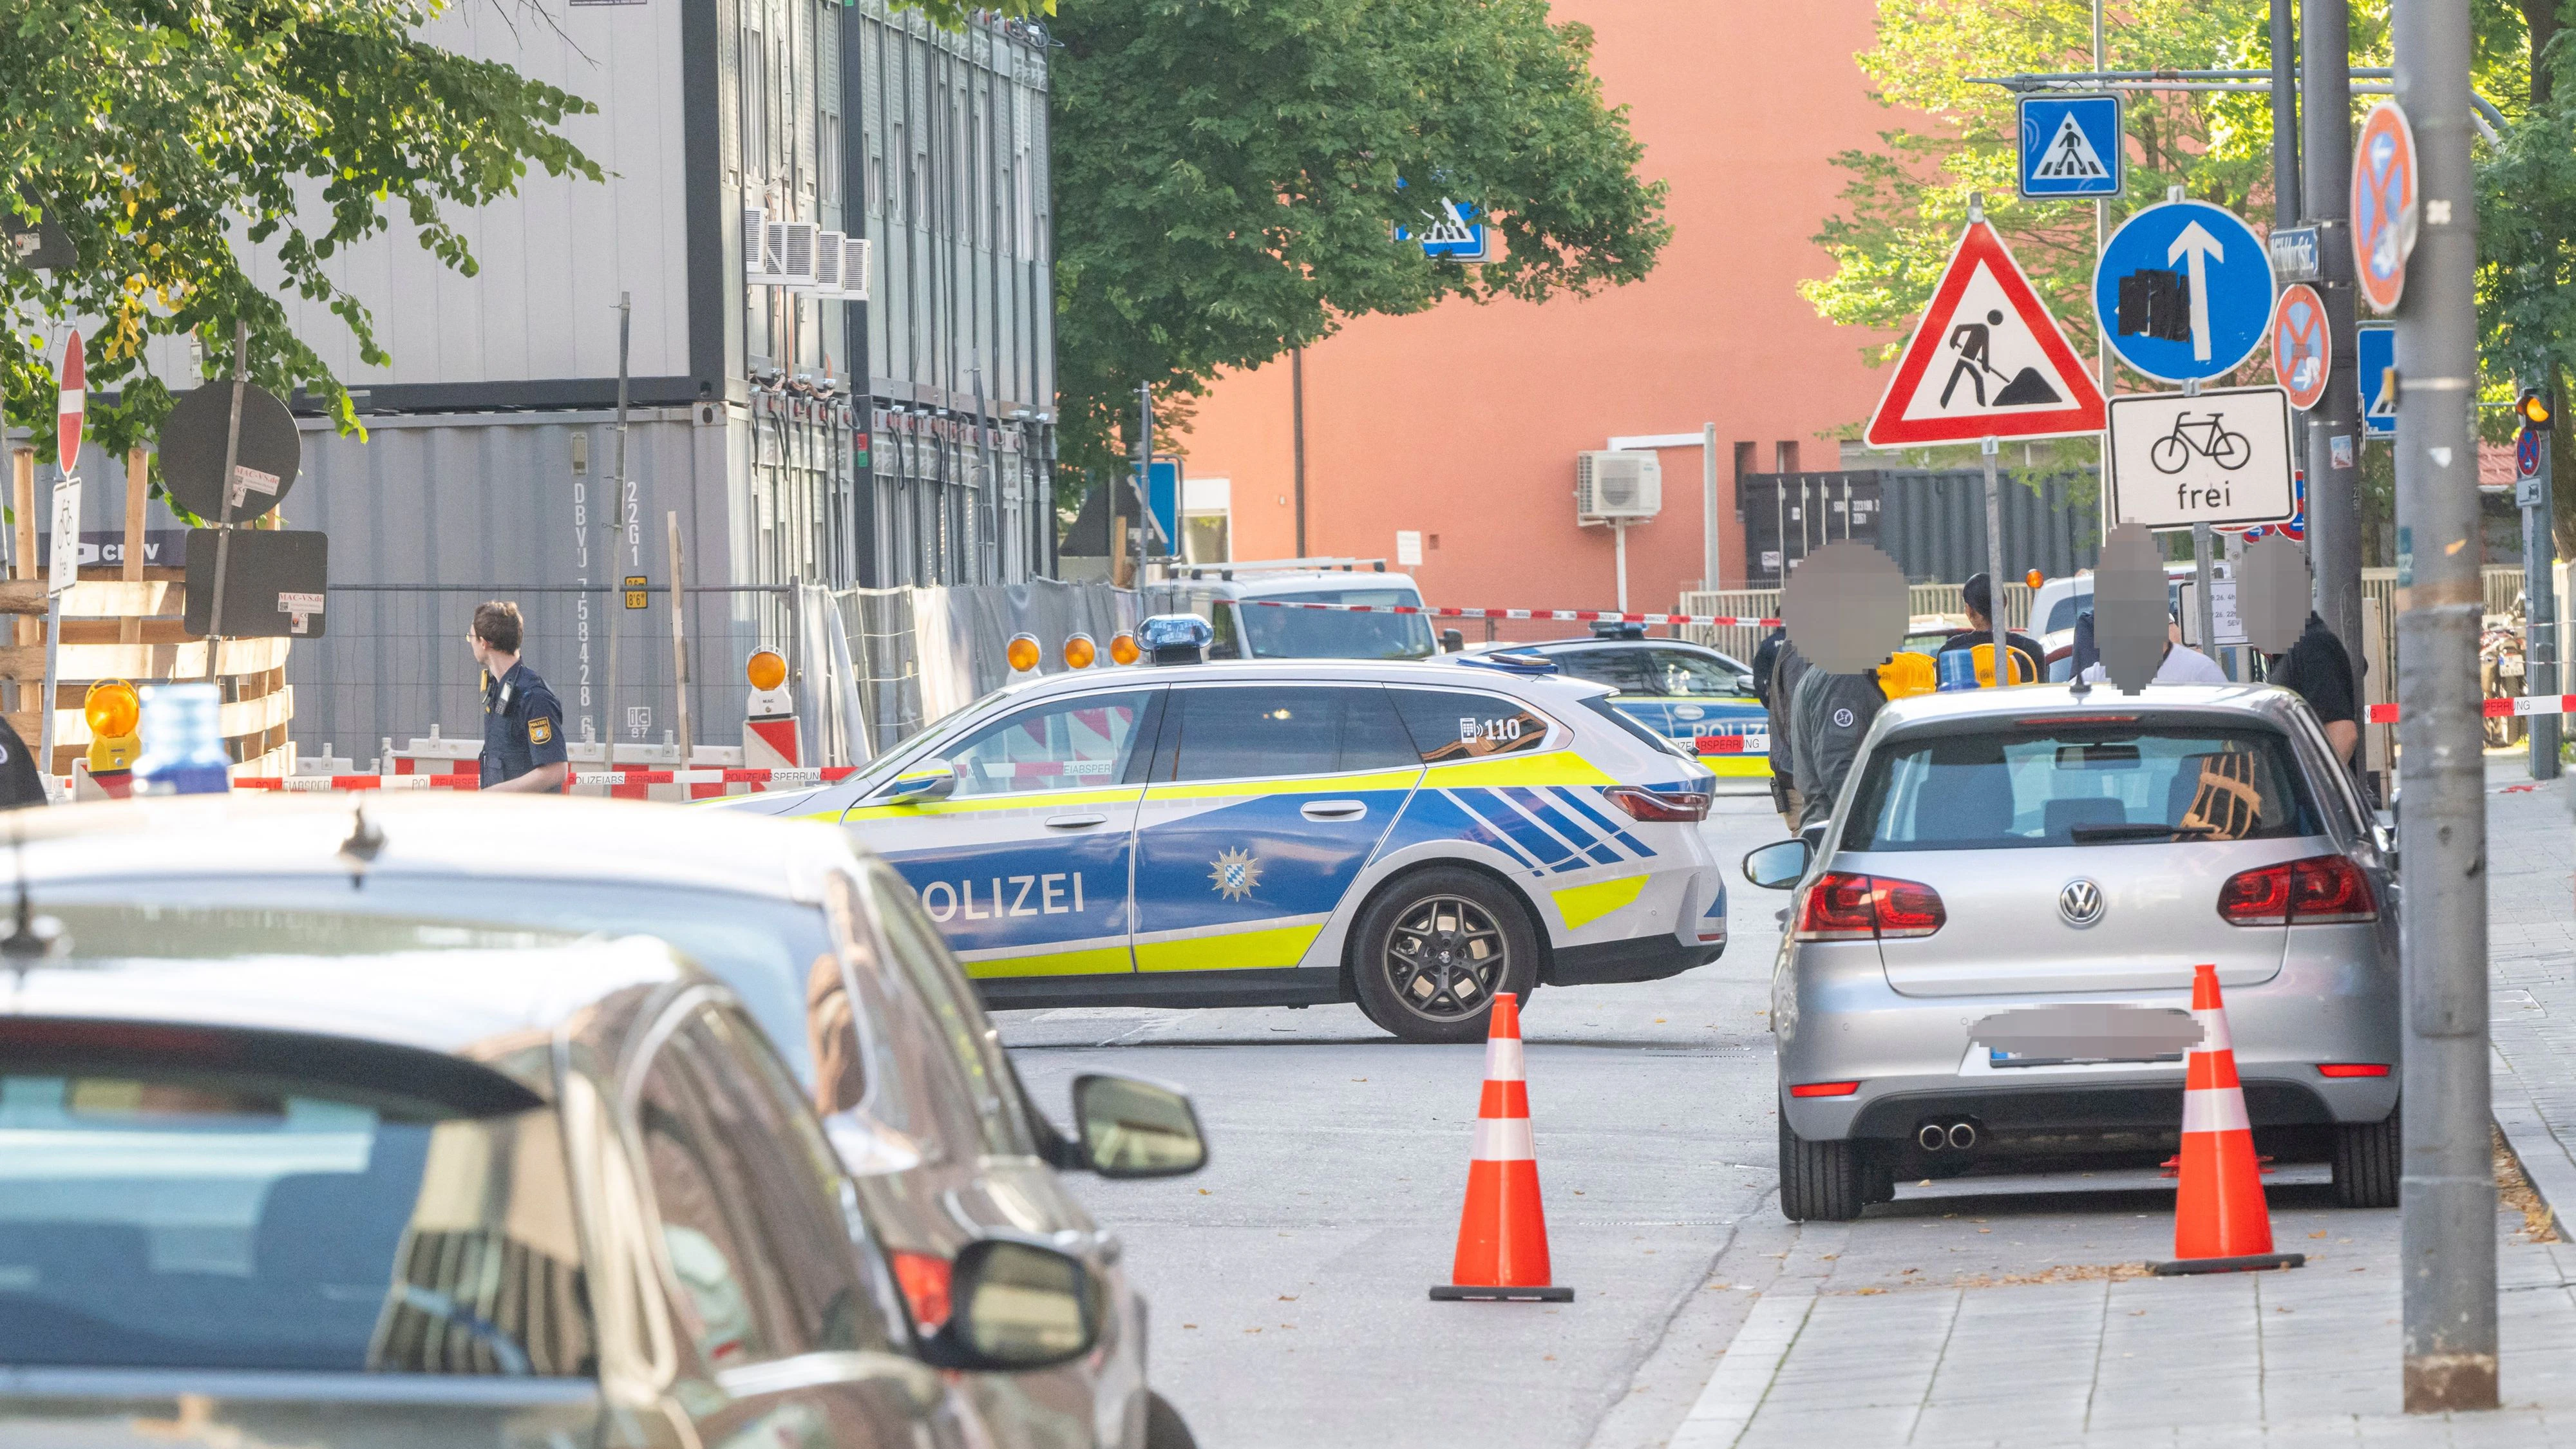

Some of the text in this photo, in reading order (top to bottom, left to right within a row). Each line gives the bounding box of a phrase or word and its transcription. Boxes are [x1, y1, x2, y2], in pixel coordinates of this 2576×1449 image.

[2177, 480, 2230, 509] frei
[627, 481, 639, 567] 22G1
[279, 594, 323, 602] MAC-VS.de
[631, 728, 648, 738] 87
[1484, 719, 1520, 741] 110
[1692, 723, 1769, 737] POLIZ
[569, 775, 670, 784] POLIZEIABSPERRUNG
[724, 772, 827, 782] POLIZEIABSPERRUNG
[922, 871, 1084, 923] OLIZEI
